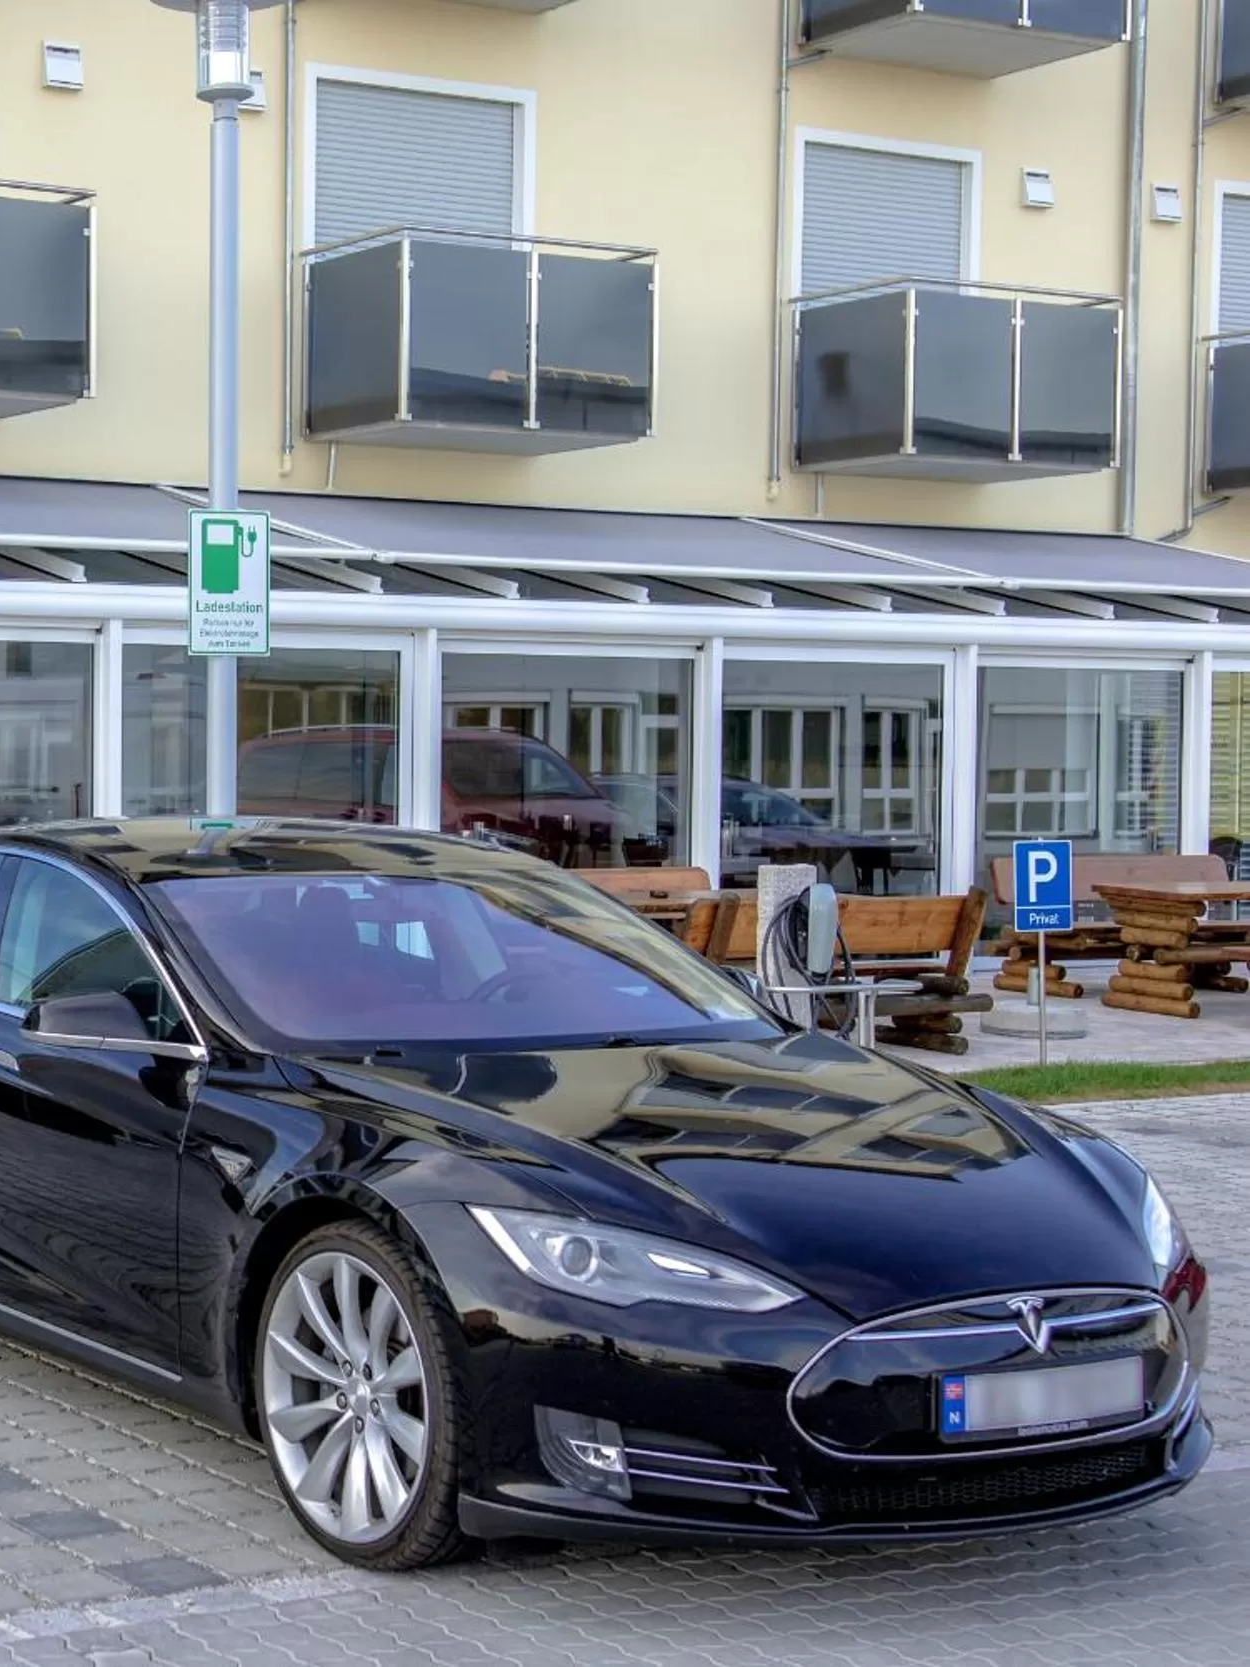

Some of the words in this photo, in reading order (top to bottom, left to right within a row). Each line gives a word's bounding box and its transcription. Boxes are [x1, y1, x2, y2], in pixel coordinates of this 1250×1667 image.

[196, 599, 263, 613] Ladestation
[1028, 850, 1058, 903] P
[1029, 912, 1060, 926] Privat
[949, 1411, 961, 1425] N
